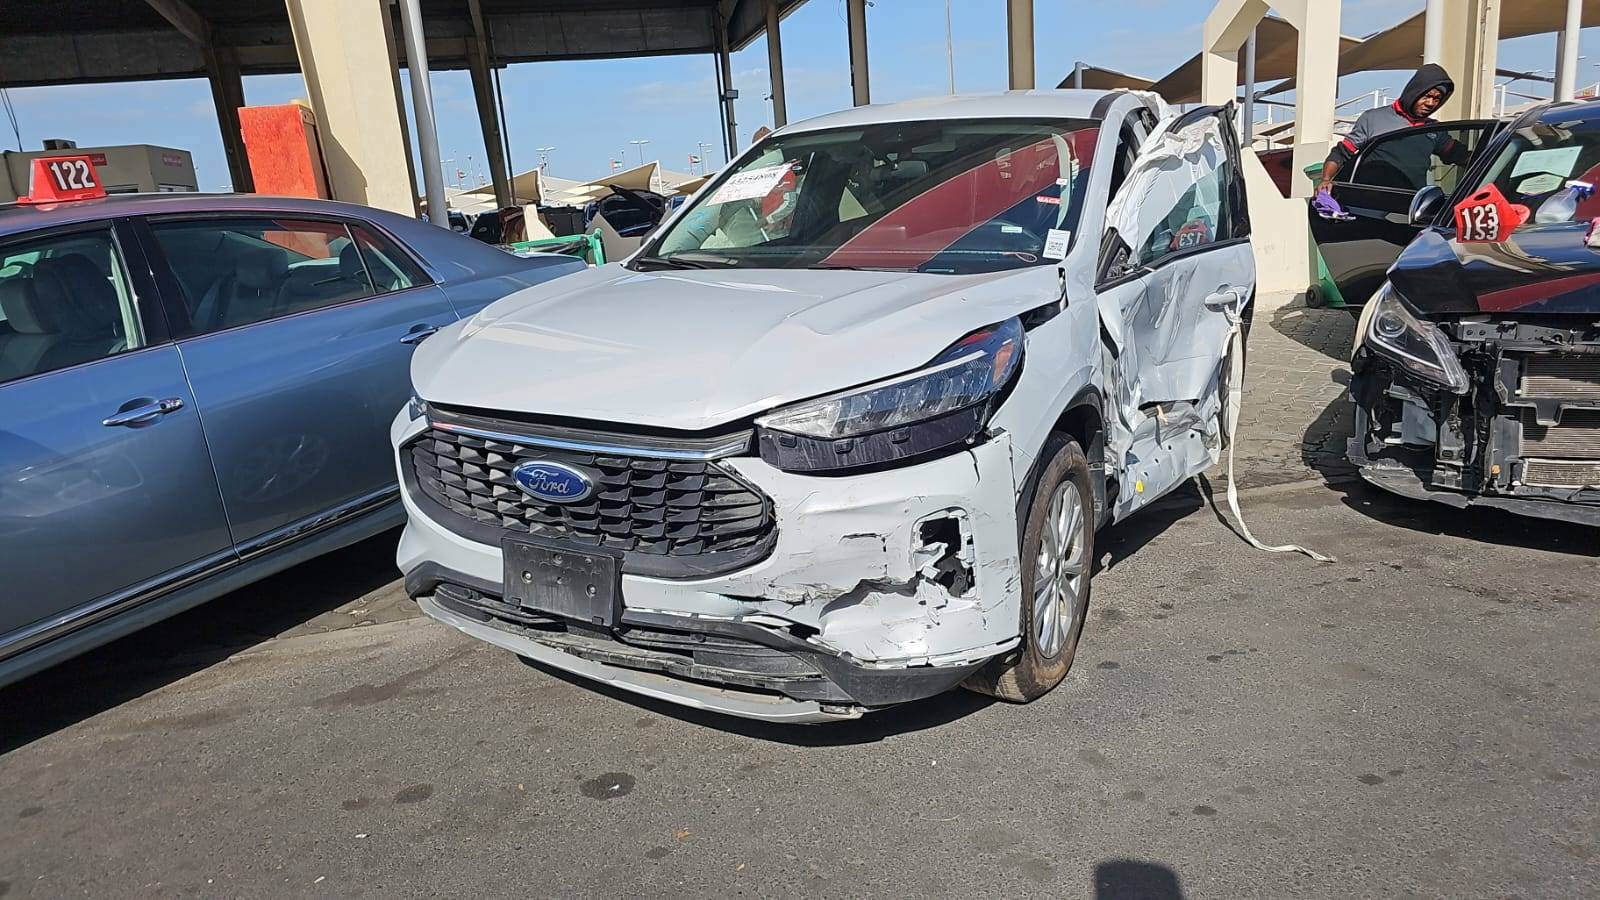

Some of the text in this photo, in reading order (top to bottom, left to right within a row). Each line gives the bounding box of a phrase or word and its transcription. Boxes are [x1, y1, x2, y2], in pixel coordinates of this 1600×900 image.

[50, 159, 96, 191] 122
[1461, 203, 1499, 228] 123
[523, 468, 570, 494] Ford
